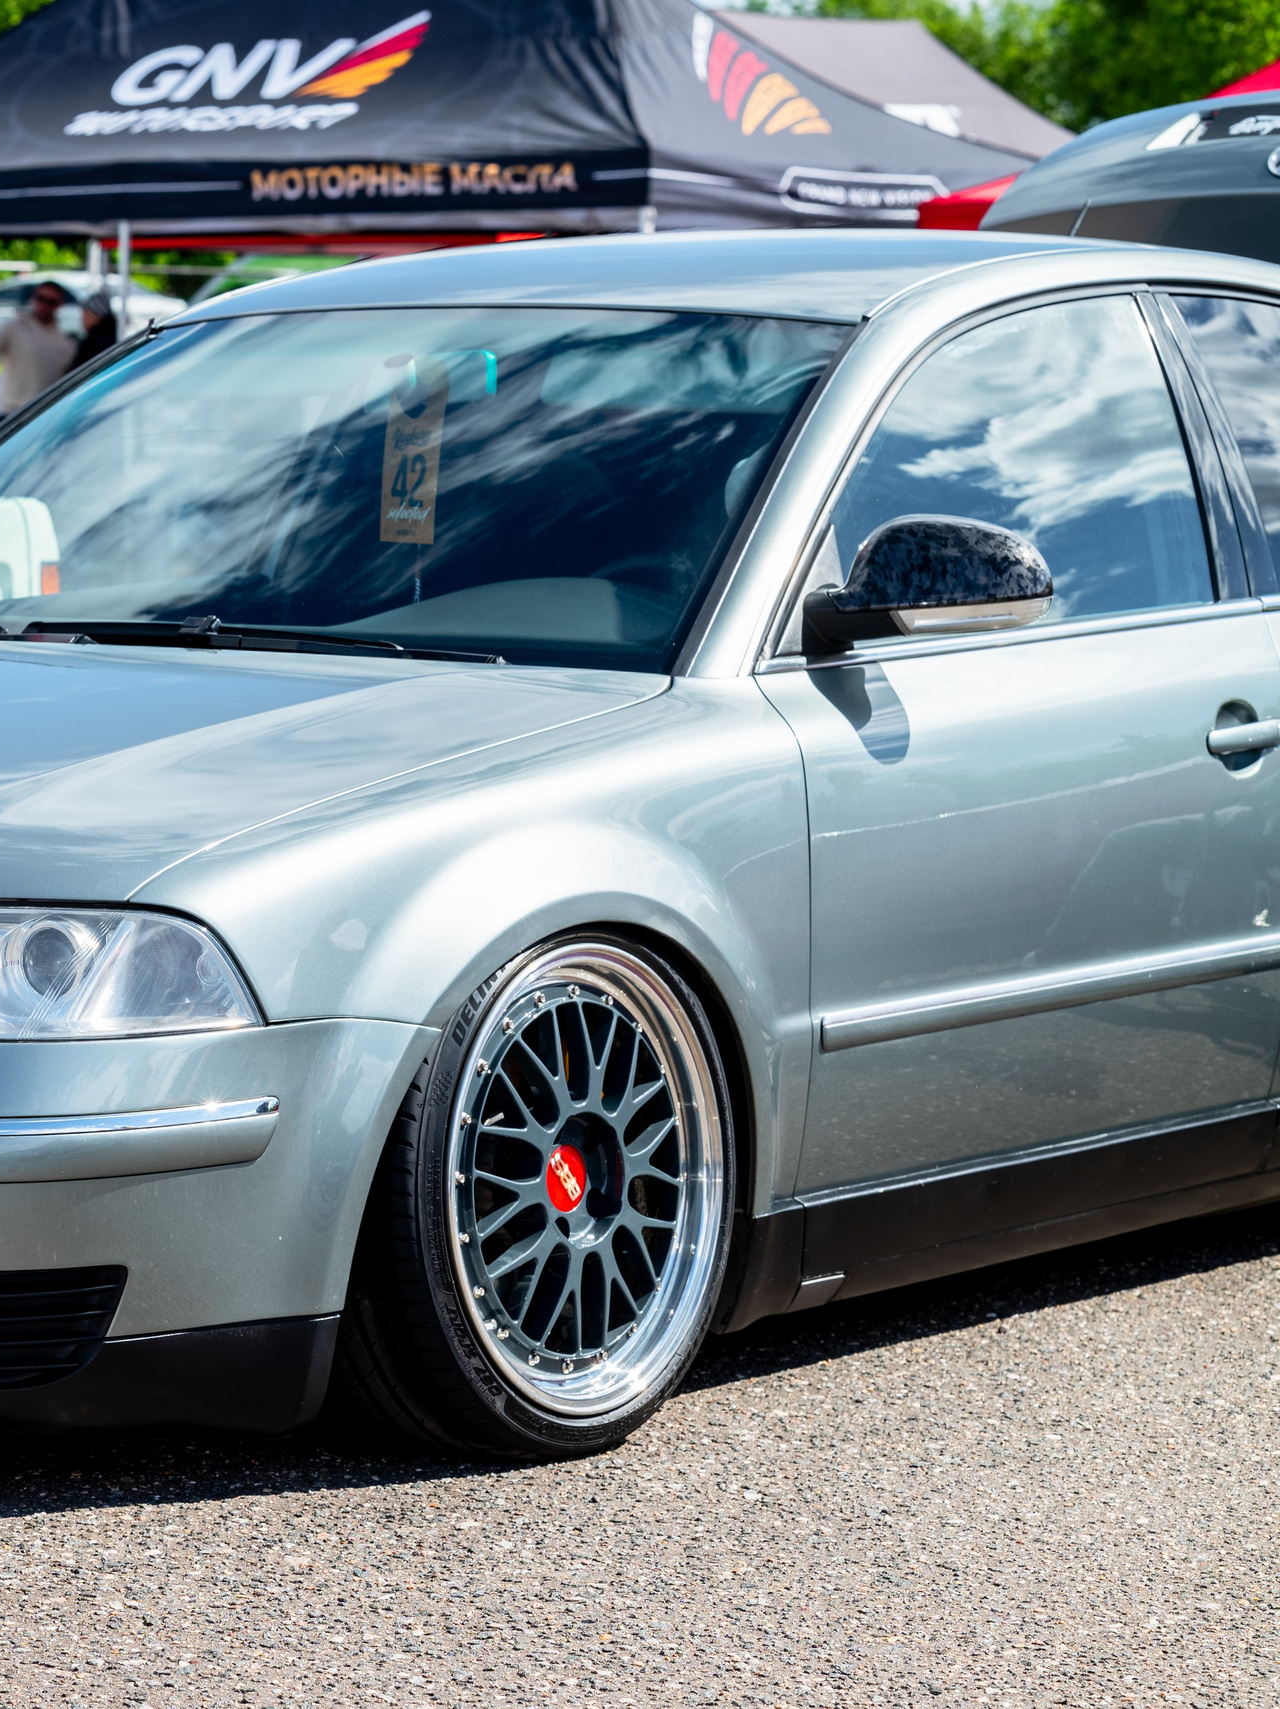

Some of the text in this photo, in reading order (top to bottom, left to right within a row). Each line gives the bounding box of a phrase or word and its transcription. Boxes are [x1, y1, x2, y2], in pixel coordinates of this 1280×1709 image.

[111, 38, 358, 106] GNV
[250, 161, 578, 201] МОТОРНЫЕ МАСЛА
[391, 453, 427, 508] 42
[550, 1152, 582, 1202] BBS
